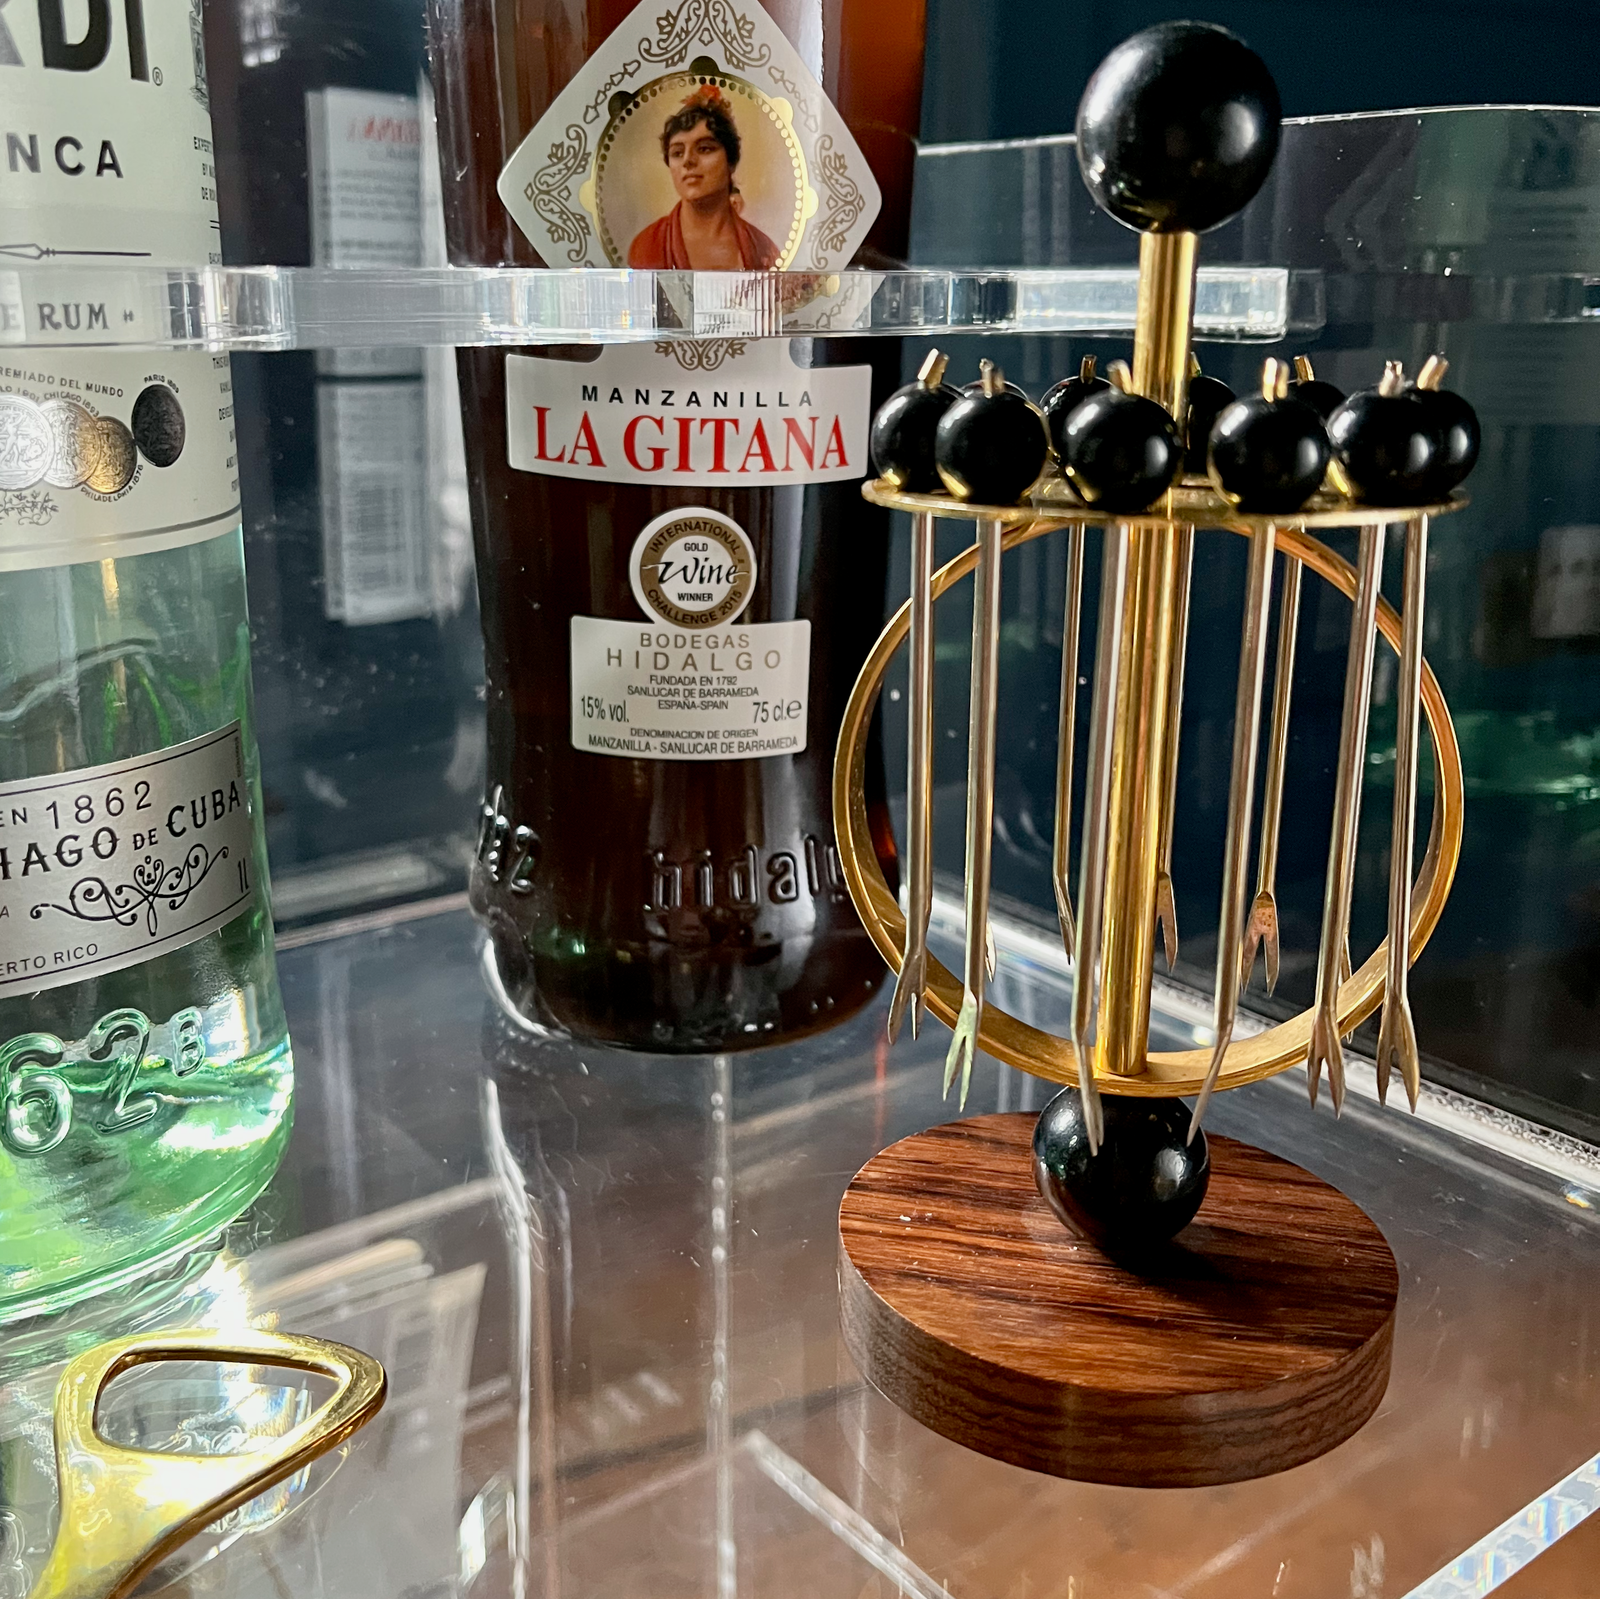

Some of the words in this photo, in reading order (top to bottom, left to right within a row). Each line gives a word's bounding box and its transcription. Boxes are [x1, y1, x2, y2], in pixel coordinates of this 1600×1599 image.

[6, 132, 124, 178] NCA
[37, 303, 110, 331] RUM
[60, 377, 82, 390] DEL
[86, 382, 124, 398] MUNDO
[144, 374, 166, 384] PARIS
[44, 390, 82, 403] CHICAGO
[582, 385, 812, 408] MANZANILLA
[532, 406, 607, 468] LA
[623, 414, 849, 473] GITANA
[80, 485, 134, 503] PHILADELPHIA
[649, 521, 740, 556] INTERNATIONAL
[683, 542, 709, 552] GOLD
[650, 557, 743, 585] Wine
[648, 589, 718, 625] CHALLENGE
[677, 592, 714, 602] WINNER
[640, 632, 750, 649] BODEGAS
[607, 647, 781, 672] HIDALGO
[649, 675, 697, 686] FUNDADA
[700, 676, 713, 686] EN
[627, 685, 680, 698] SANLUCAR
[683, 688, 696, 699] DE
[699, 687, 759, 699] BARRAMEDA
[581, 696, 605, 720] 15%
[609, 700, 630, 723] vol.
[752, 701, 769, 724] 75
[588, 734, 651, 752] MANZANILLA
[660, 741, 718, 754] SANLUCAR
[721, 742, 735, 753] DE
[738, 735, 798, 752] BARRAMEDA
[630, 728, 703, 740] DENOMINACION
[707, 729, 721, 740] DE
[723, 728, 758, 739] ORIGEN
[46, 780, 152, 830] 1862
[133, 828, 159, 850] DE
[166, 780, 241, 838] CUBA
[53, 943, 98, 965] RICO
